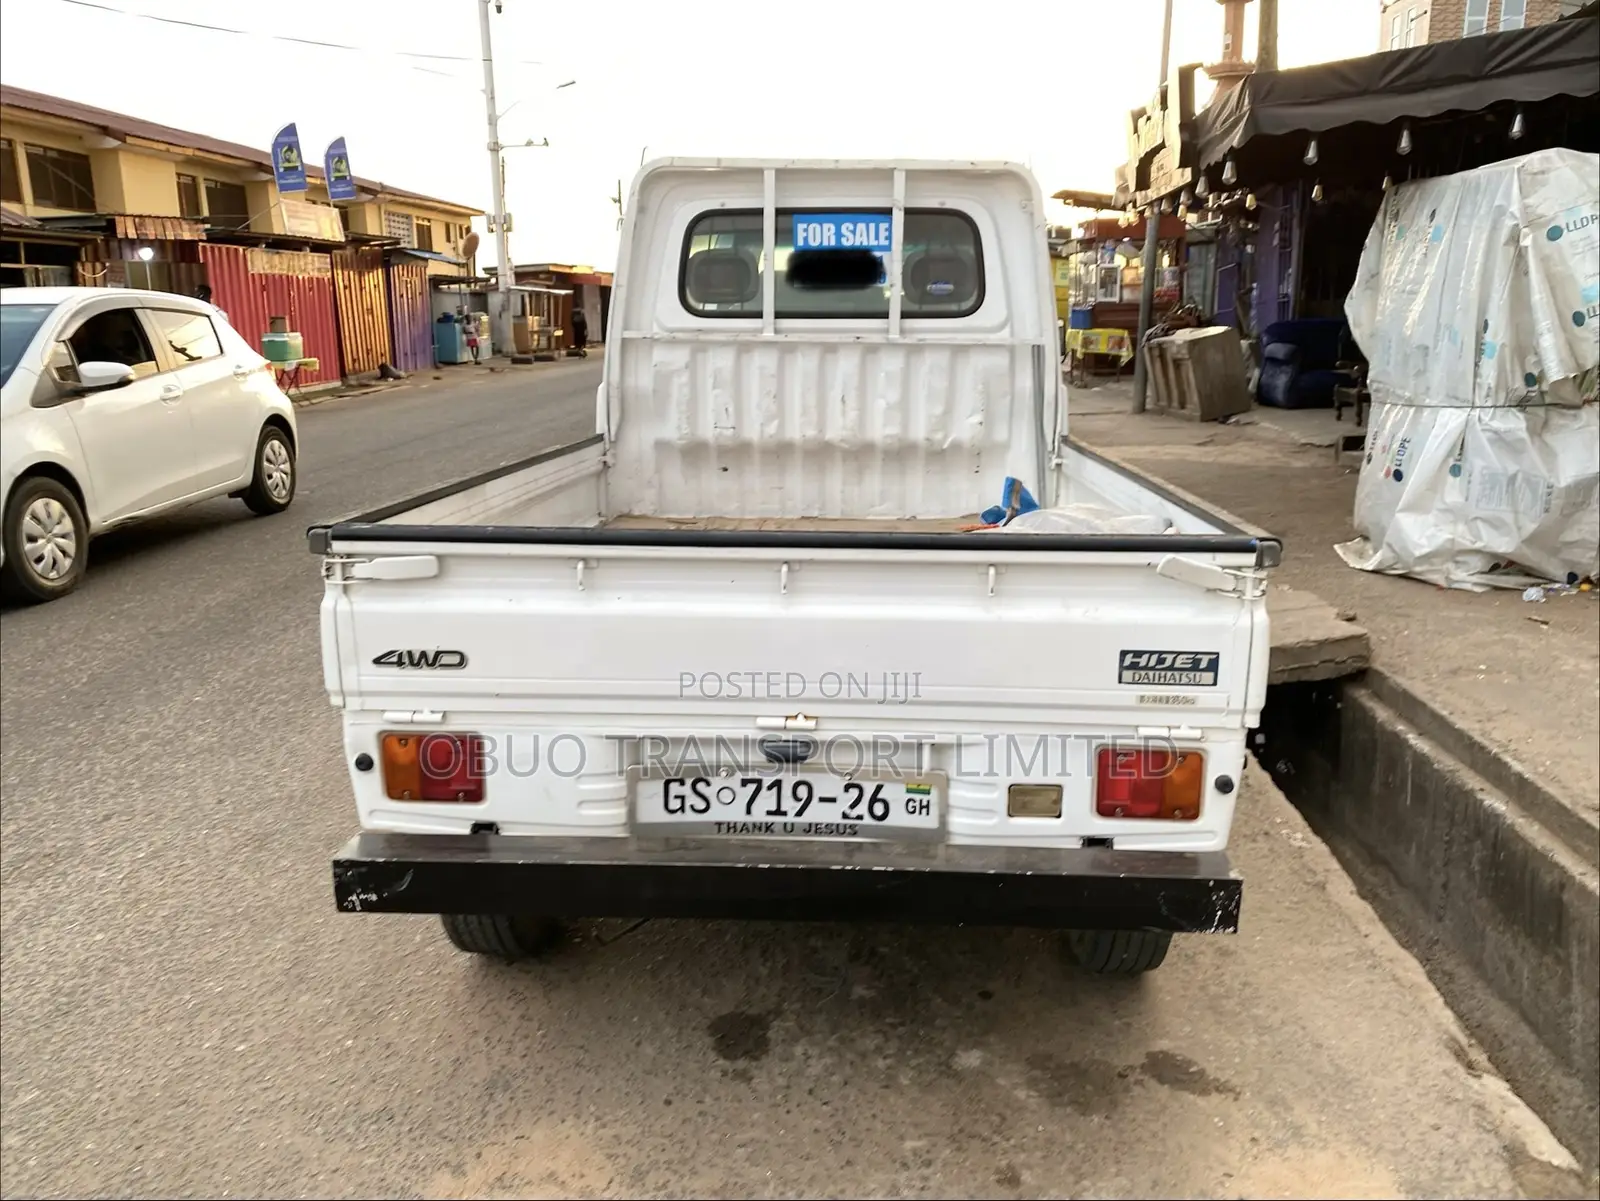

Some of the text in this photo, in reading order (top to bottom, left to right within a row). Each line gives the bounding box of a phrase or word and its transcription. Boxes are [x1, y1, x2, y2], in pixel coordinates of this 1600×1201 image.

[797, 223, 890, 247] FOR SALE
[372, 649, 468, 669] 4WD
[1122, 652, 1218, 669] HIJET
[1131, 671, 1203, 684] DAIHATSU
[905, 797, 931, 817] GH
[714, 821, 859, 837] THANK U JESUS
